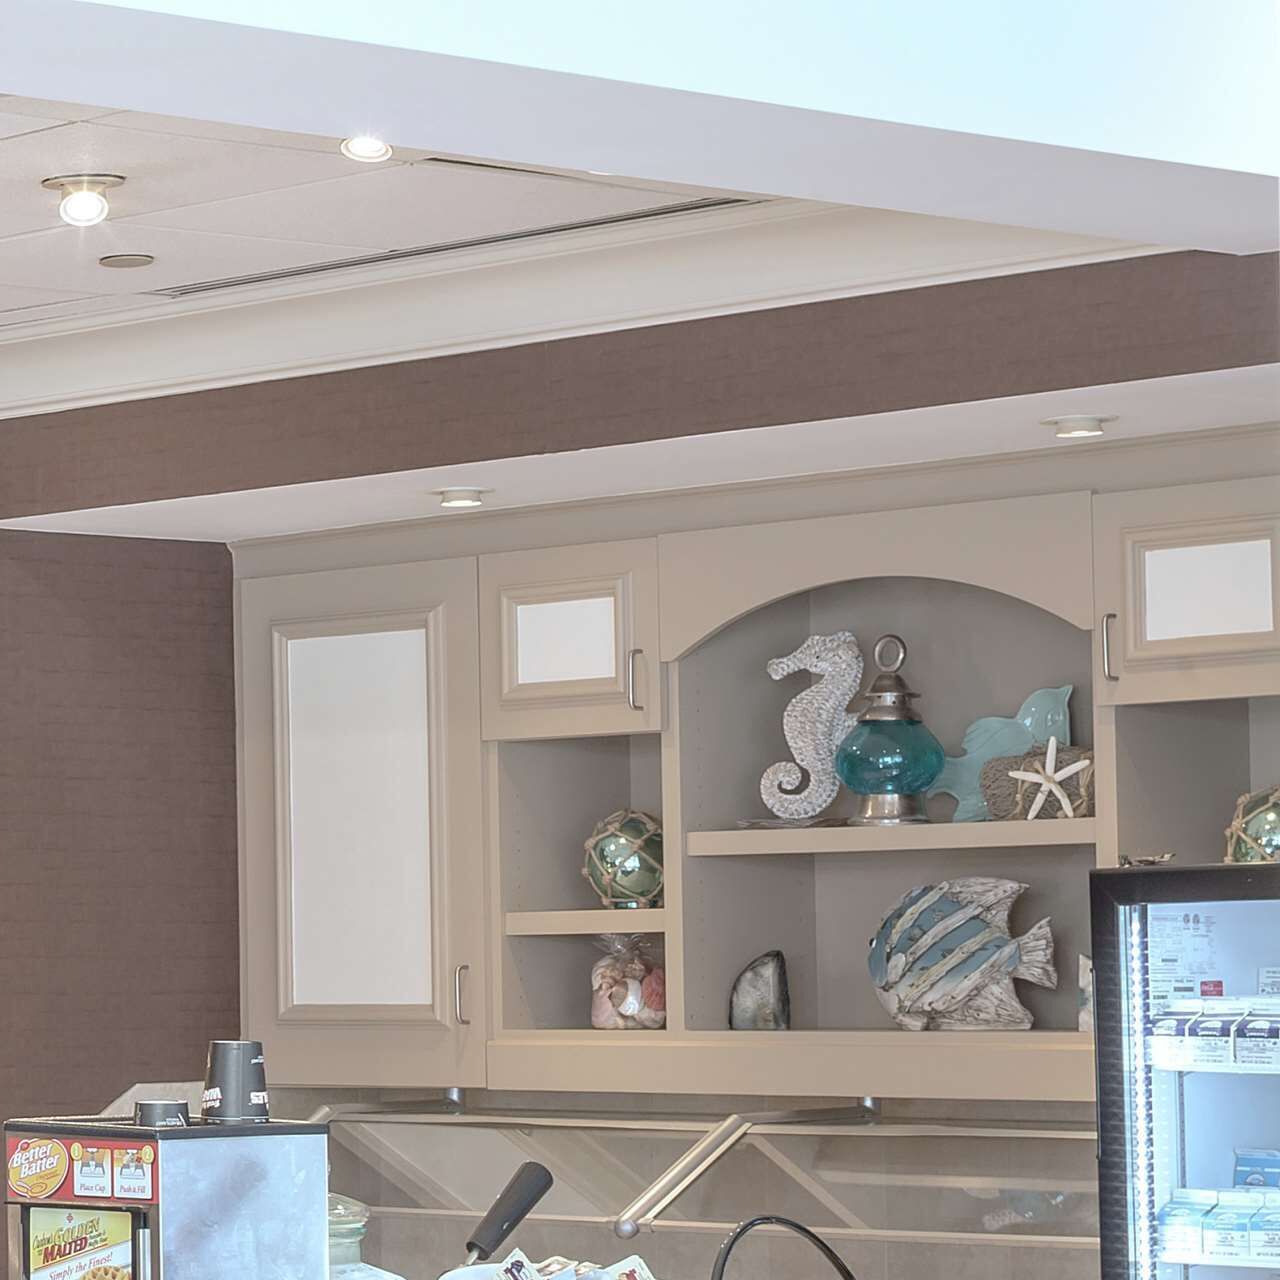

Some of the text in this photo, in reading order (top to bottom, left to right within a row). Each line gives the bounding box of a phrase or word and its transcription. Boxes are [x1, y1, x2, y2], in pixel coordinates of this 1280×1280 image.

[13, 1143, 53, 1168] Better
[20, 1154, 60, 1178] Batter
[53, 1217, 100, 1243] GOLDEN
[43, 1237, 88, 1264] MALTED
[75, 1261, 87, 1272] the
[89, 1252, 113, 1267] Finest!
